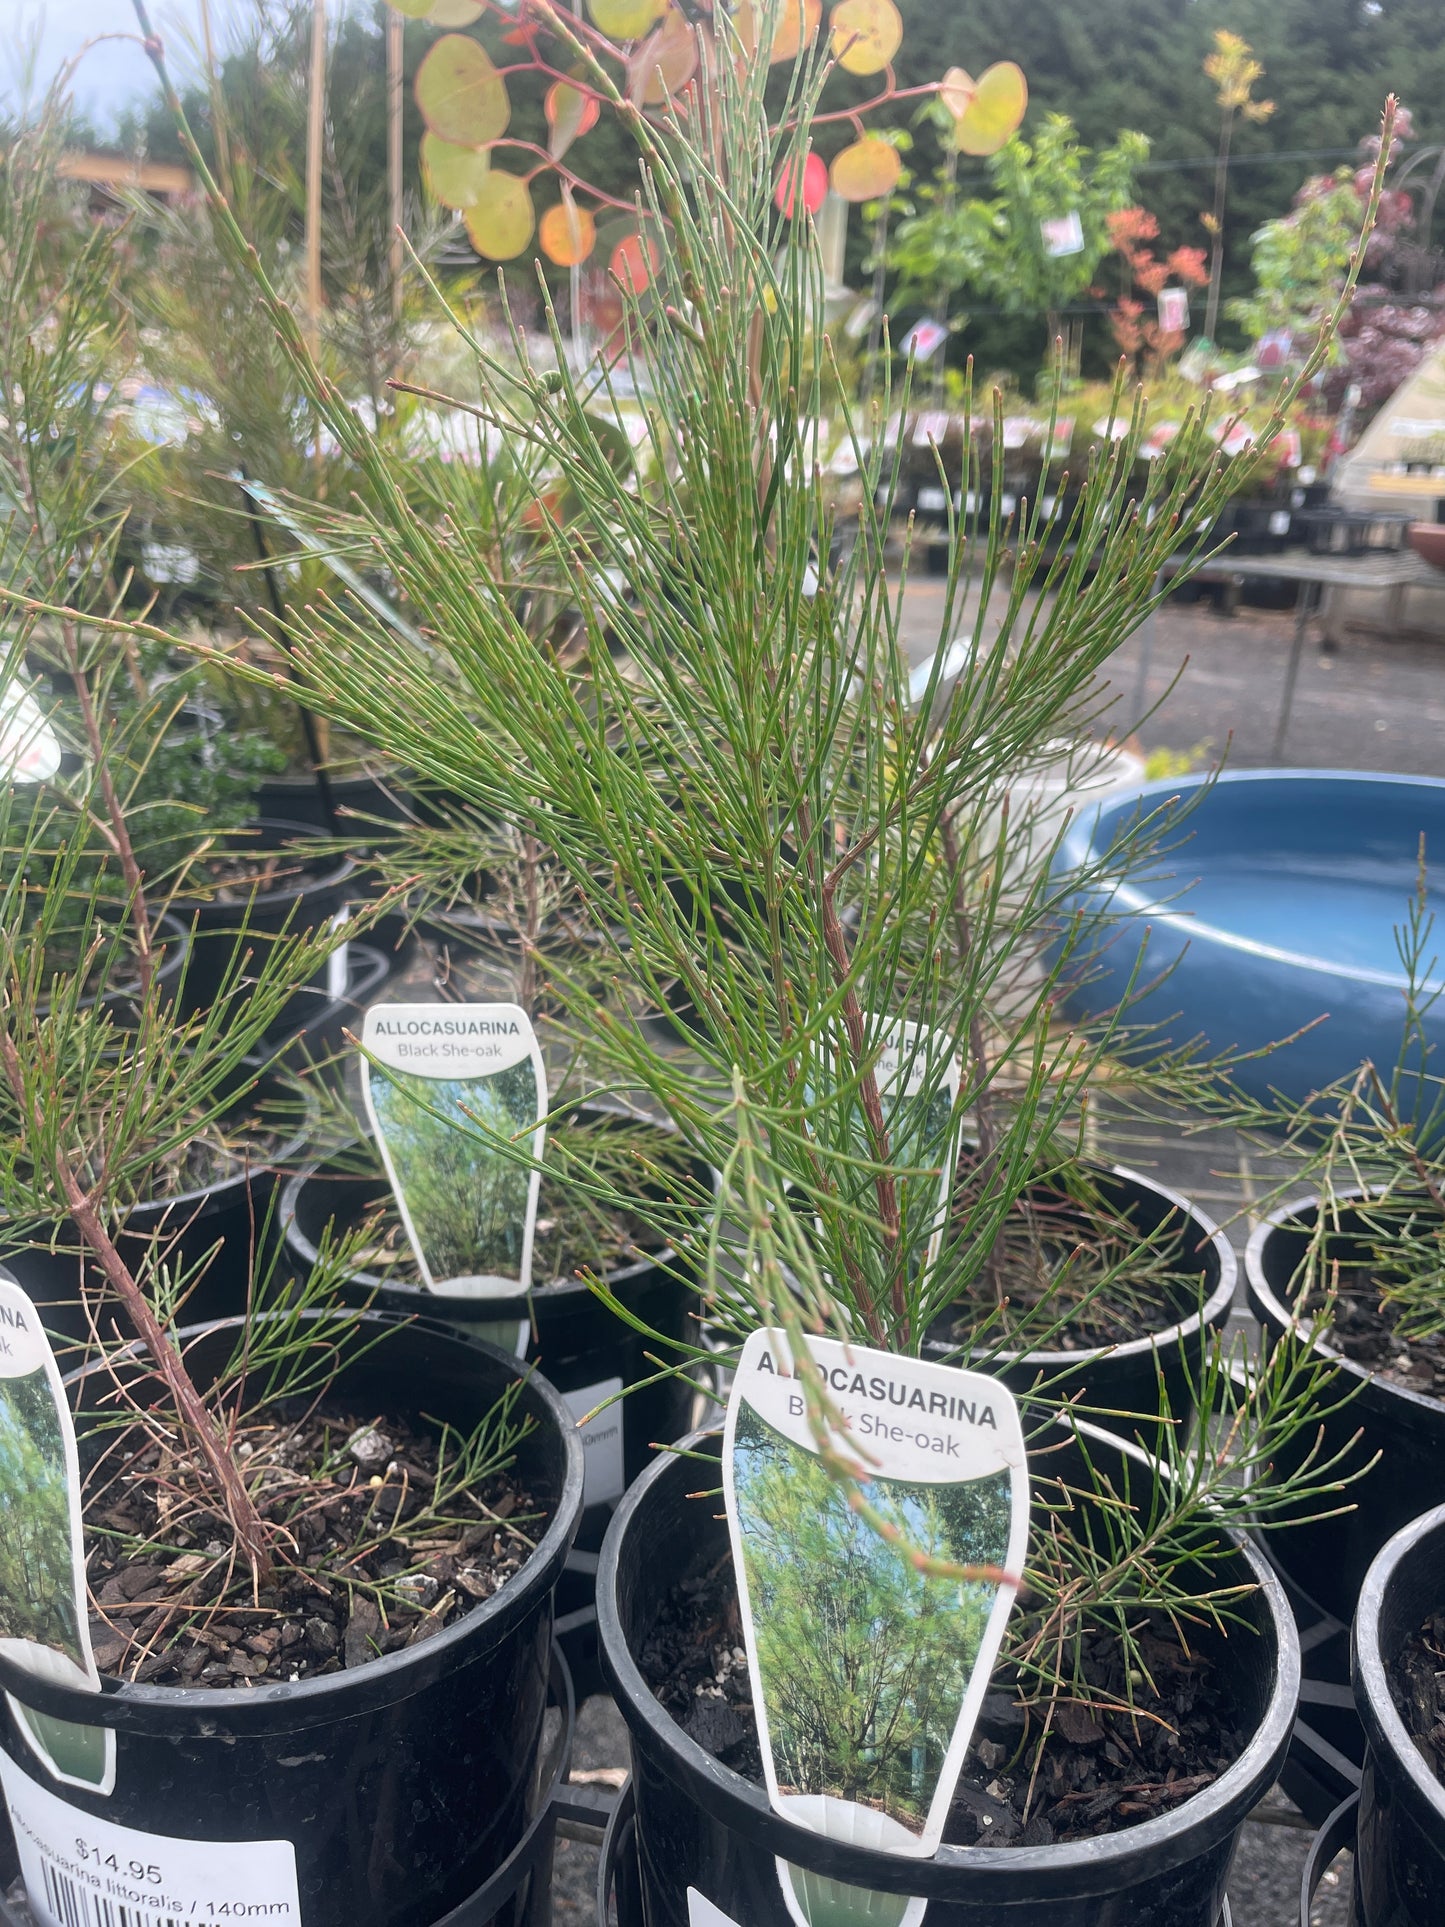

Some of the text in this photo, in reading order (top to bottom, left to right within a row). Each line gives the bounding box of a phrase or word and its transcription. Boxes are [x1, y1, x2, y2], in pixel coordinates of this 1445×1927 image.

[375, 1021, 520, 1036] ALLOCASUARINA
[398, 1043, 503, 1057] Black She-oak
[859, 1413, 961, 1458] She-oak
[75, 1837, 163, 1885] $14.95
[107, 1879, 183, 1913] littoralis
[206, 1901, 290, 1917] 140mm
